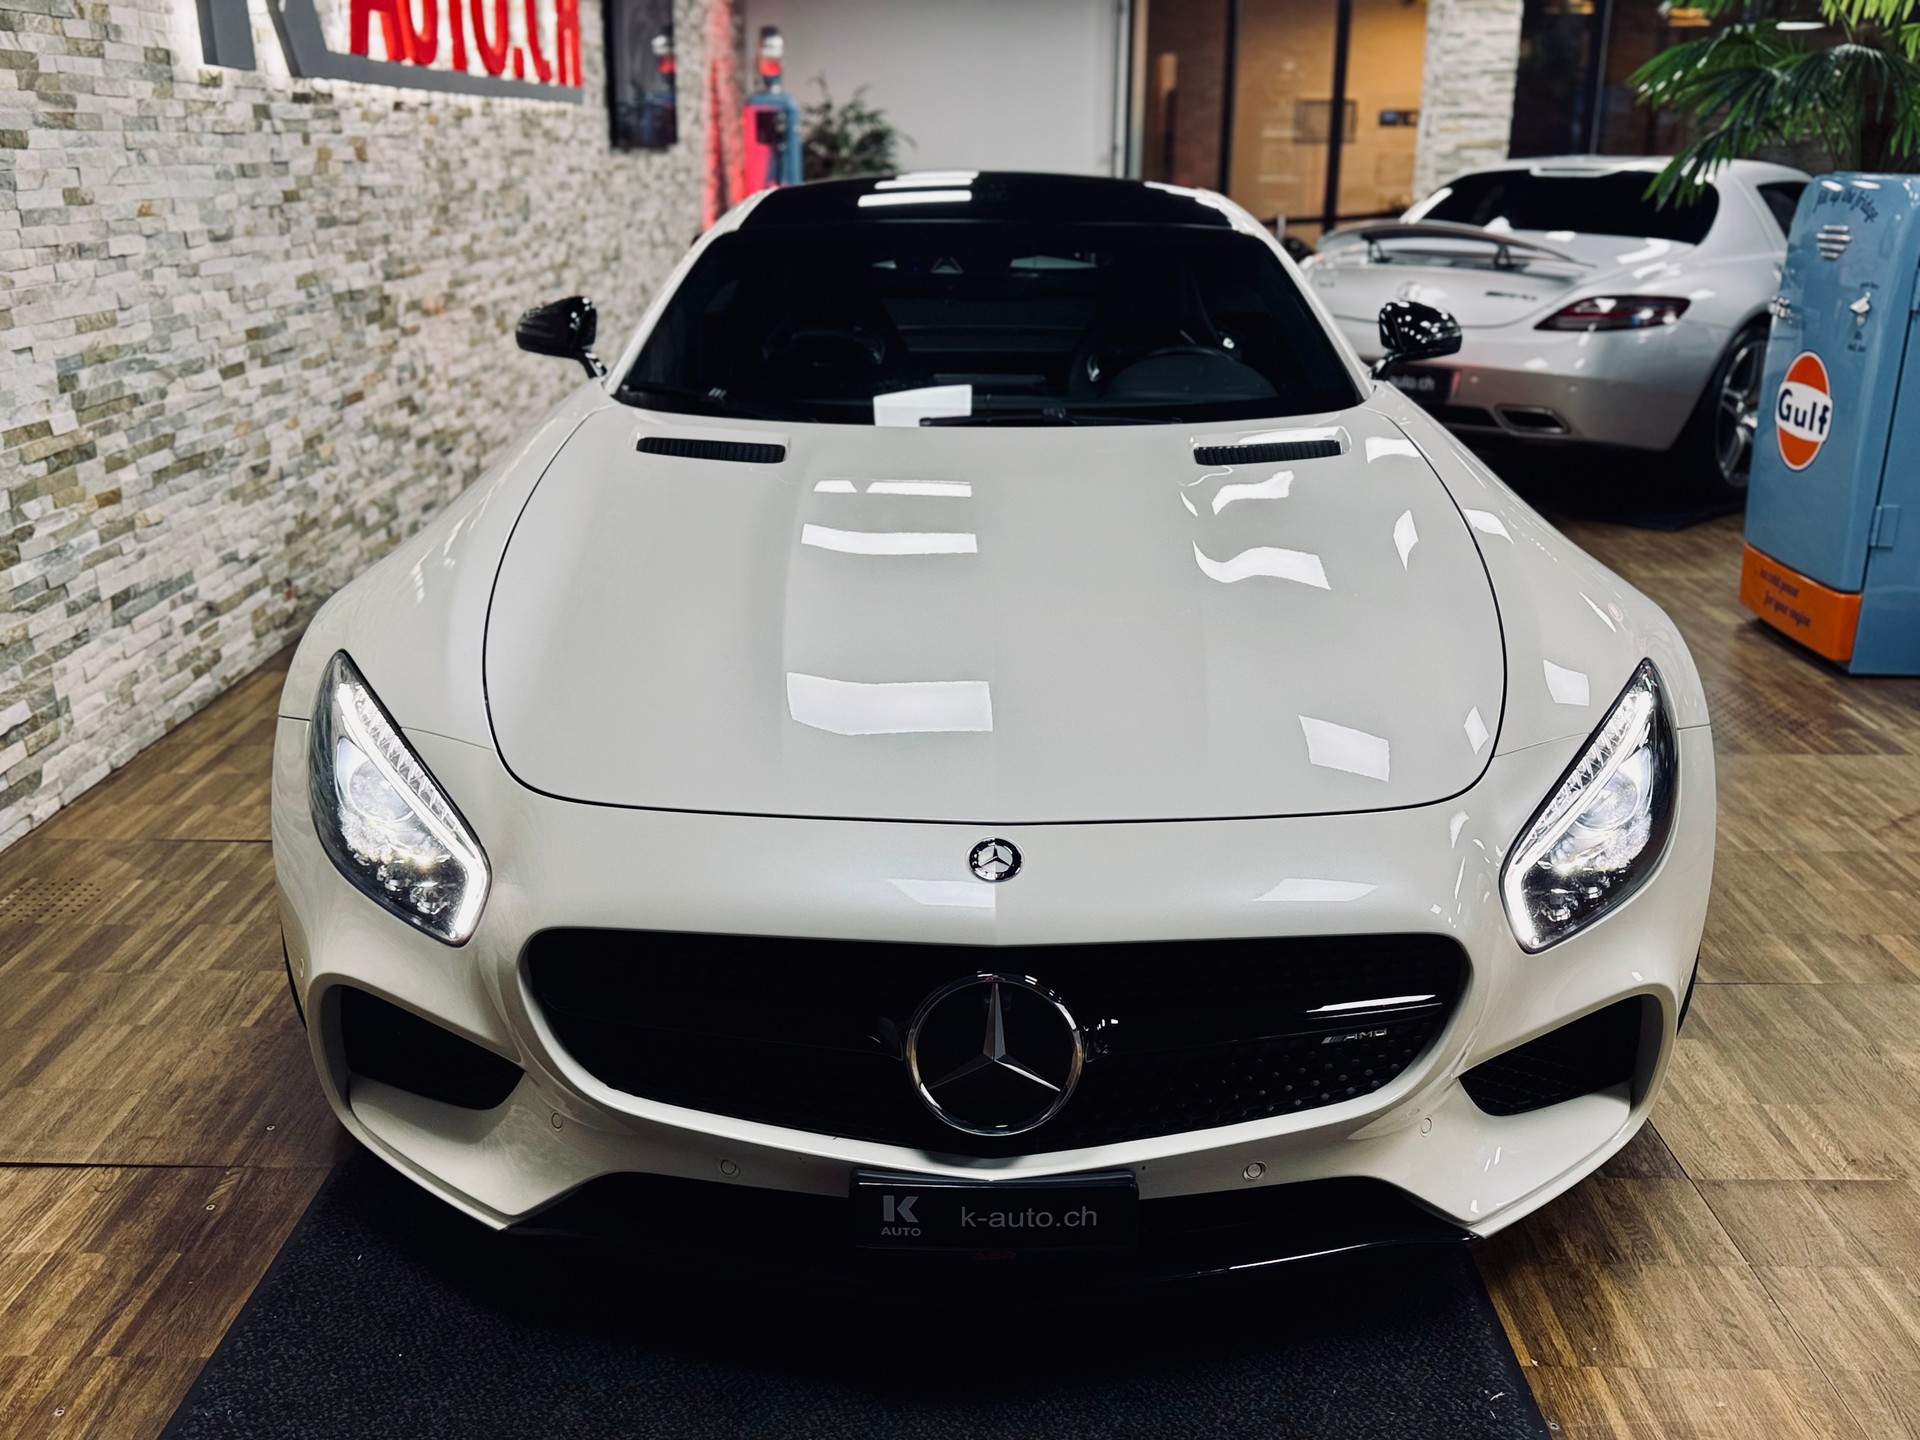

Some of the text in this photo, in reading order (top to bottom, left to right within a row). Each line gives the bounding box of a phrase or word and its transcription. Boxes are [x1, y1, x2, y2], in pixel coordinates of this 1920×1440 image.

[1777, 387, 1830, 435] Gulf
[883, 1195, 919, 1223] K
[960, 1206, 1098, 1228] k-auto.ch
[881, 1226, 921, 1236] AUTO
